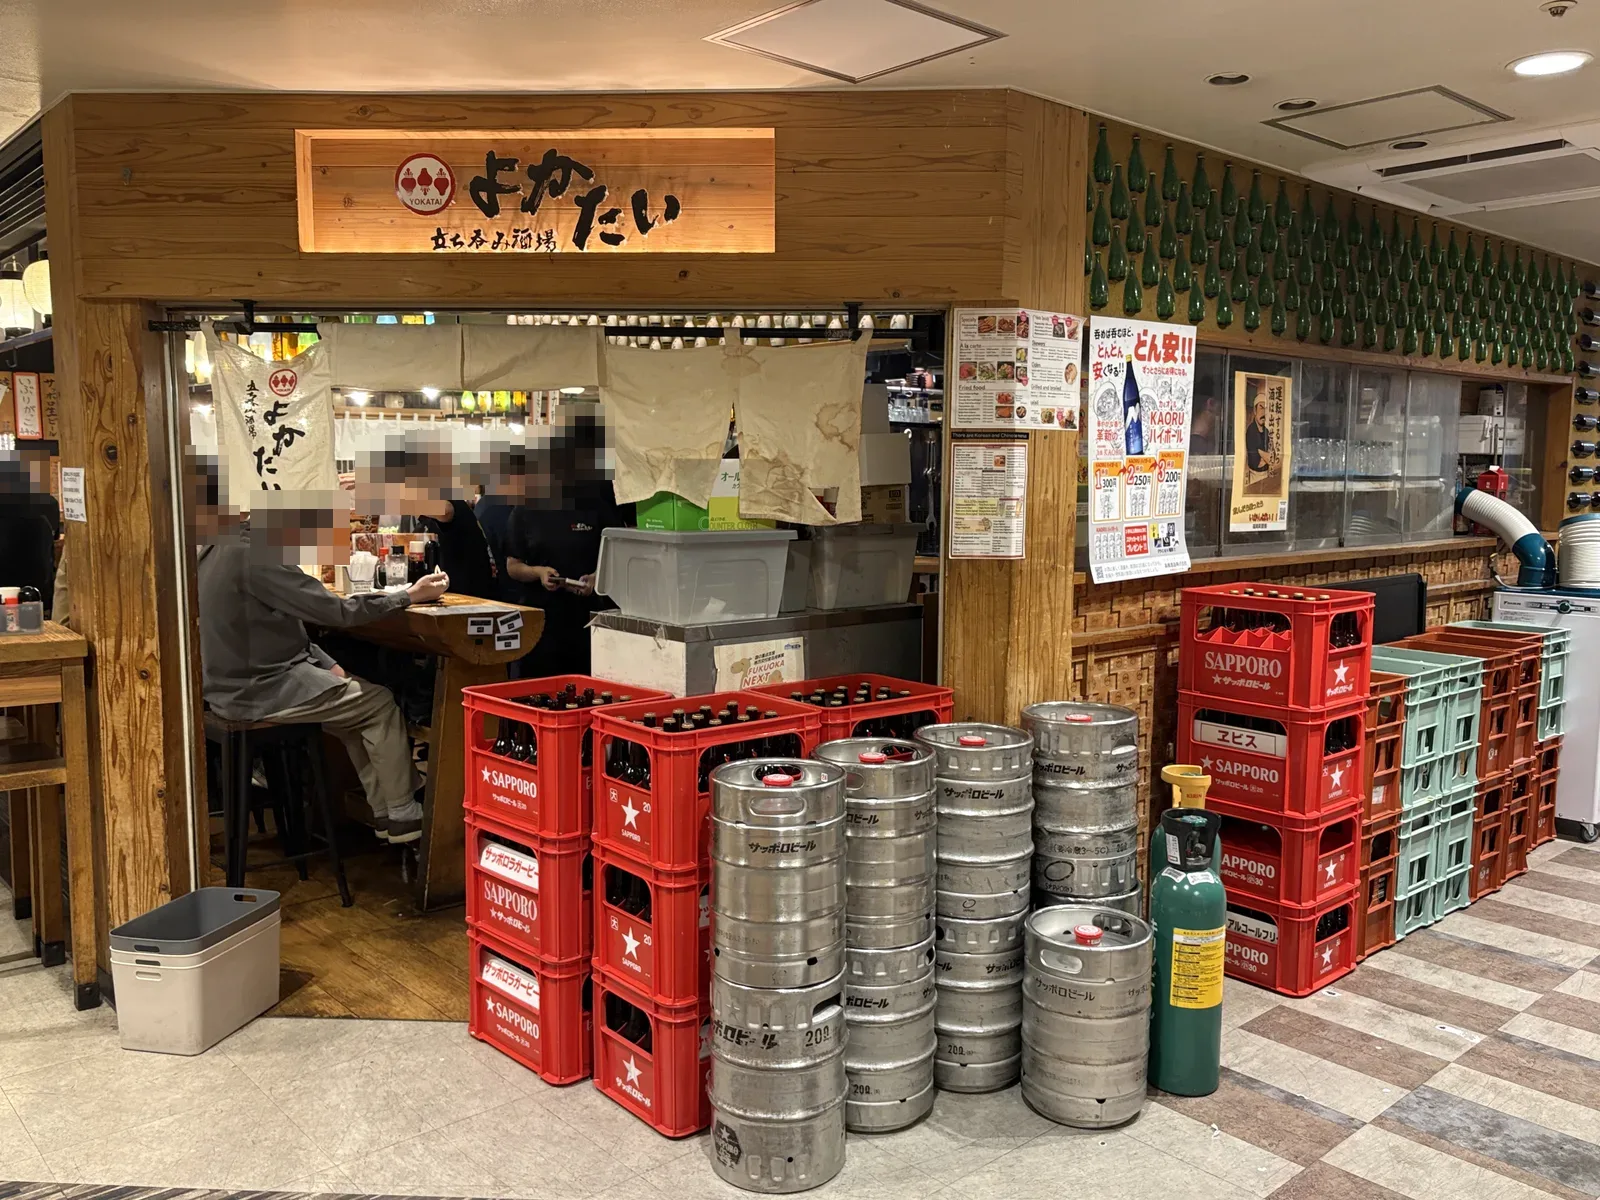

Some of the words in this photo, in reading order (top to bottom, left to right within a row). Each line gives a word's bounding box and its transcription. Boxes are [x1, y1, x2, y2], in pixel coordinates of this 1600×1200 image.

[409, 198, 442, 206] YOKATAI
[469, 149, 681, 250] よかたい
[430, 227, 557, 251] 立ち呑み酒場
[1094, 327, 1134, 340] 呑めば呑むほど、
[1098, 342, 1123, 359] どんどん
[1134, 329, 1193, 364] どん安!!
[1093, 362, 1124, 380] 安くなる!!
[1150, 411, 1184, 425] KAORU
[1149, 429, 1183, 443] ハイボール
[747, 660, 785, 675] FUKUOKA
[1205, 651, 1282, 678] SAPPORO
[743, 672, 771, 687] NEXT
[1222, 675, 1271, 690] サッポロビール
[1034, 761, 1086, 775] サッポロビール
[1216, 758, 1279, 783] SAPPORO
[492, 770, 537, 798] SAPPORO
[1215, 778, 1249, 791] サッポロビール
[944, 787, 1004, 800] サッポロビール
[643, 801, 651, 813] 20
[846, 813, 880, 825] ロビール
[621, 829, 641, 843] SAPPORO
[749, 840, 816, 854] サッポロビール
[1222, 853, 1275, 879] APPORO
[484, 880, 537, 921] SAPPORO
[497, 912, 531, 933] サッポロビール
[643, 934, 652, 946] 20
[1225, 941, 1268, 965] PPORO
[622, 957, 641, 973] SAPPORO
[1035, 976, 1096, 1002] サッポロビール
[846, 995, 890, 1009] ポロビール
[496, 1004, 539, 1039] SAPPORO
[714, 1019, 778, 1049] ポロビール
[616, 1077, 651, 1107] サッポロビール
